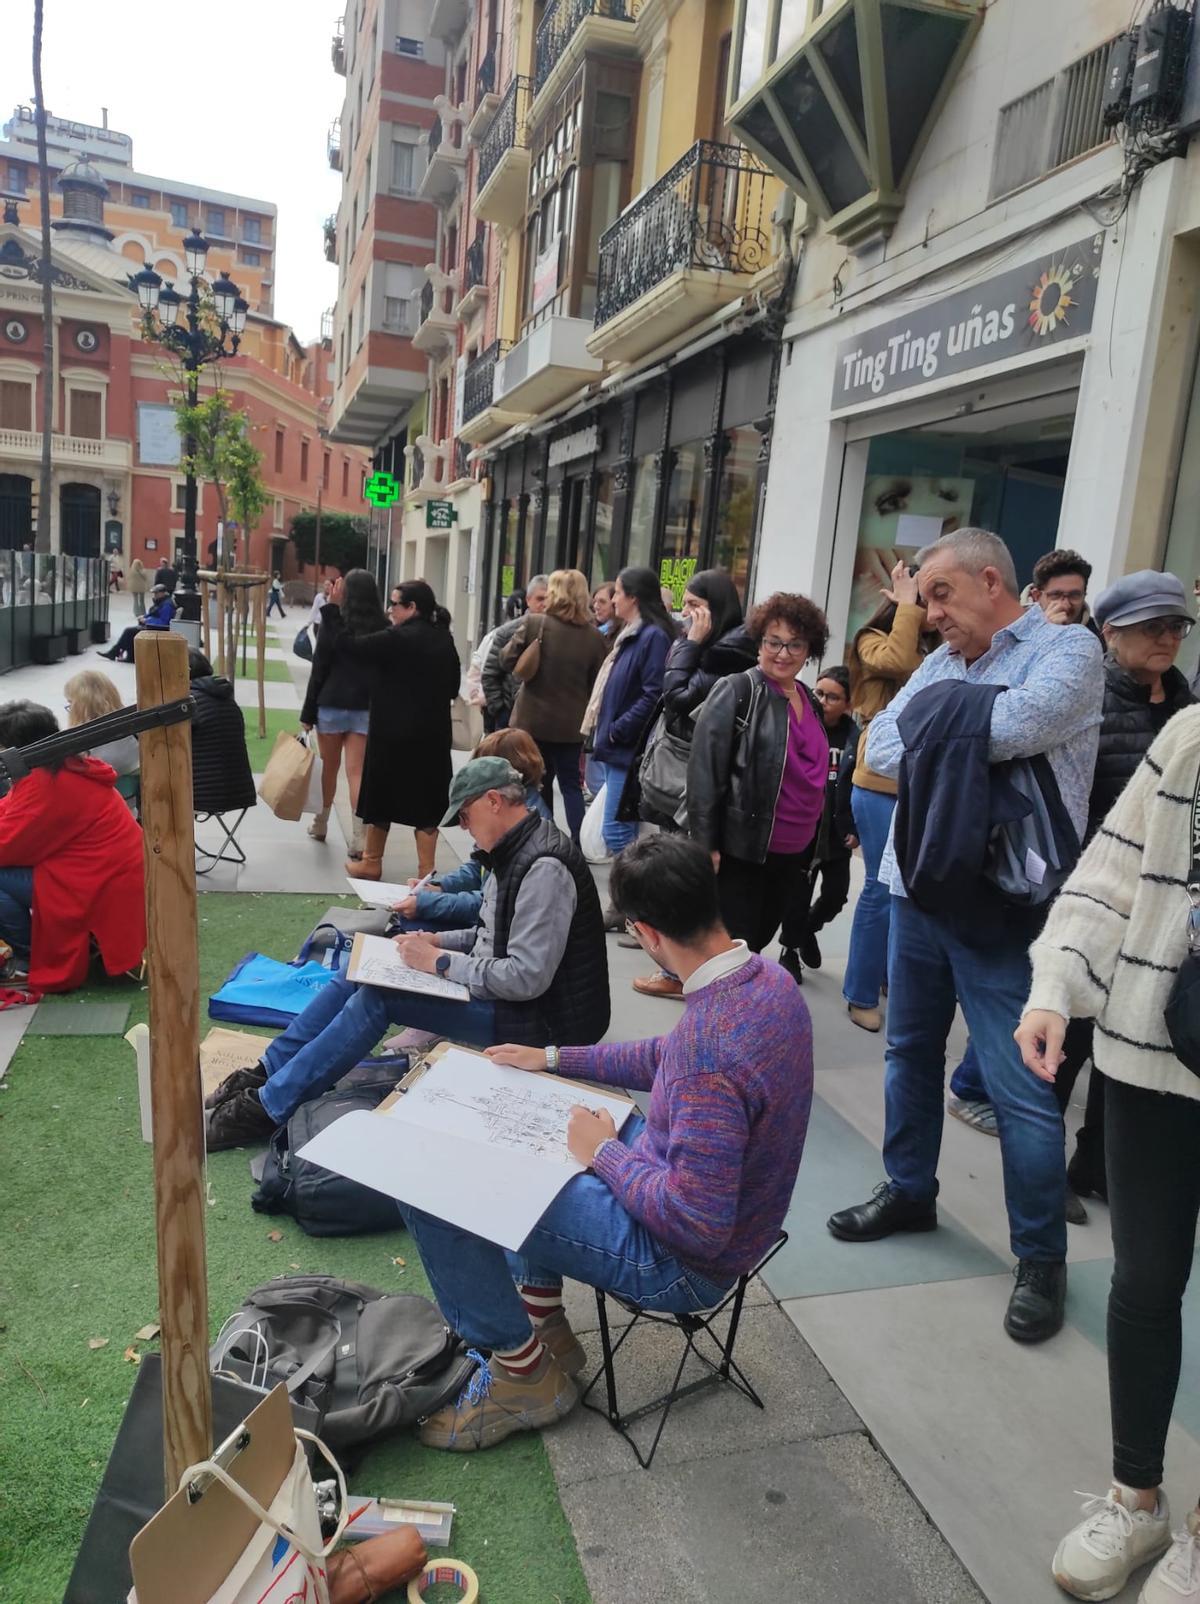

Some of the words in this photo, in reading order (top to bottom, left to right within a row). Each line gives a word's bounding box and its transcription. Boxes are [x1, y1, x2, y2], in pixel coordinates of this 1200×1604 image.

[6, 290, 58, 306] PRINCIL
[947, 304, 1015, 356] uñas
[432, 519, 448, 527] ATM
